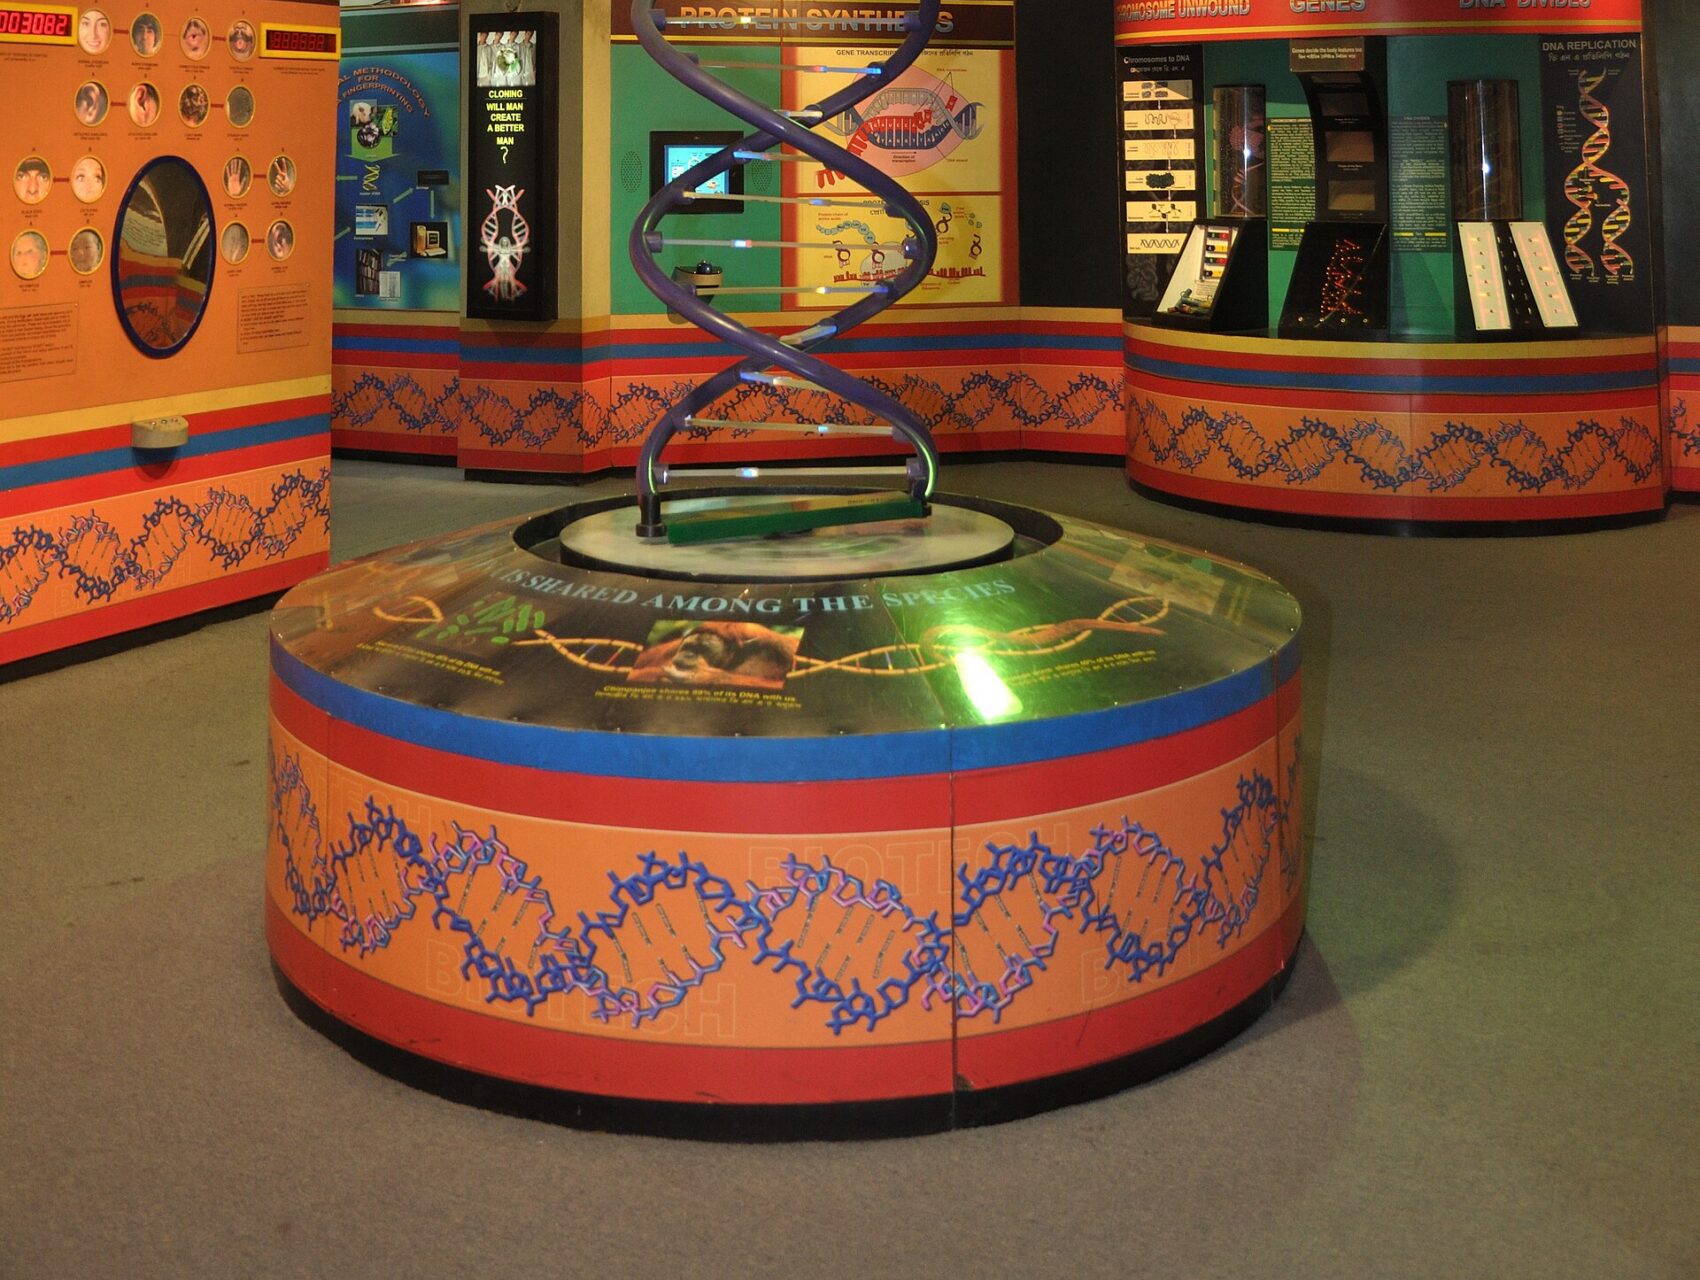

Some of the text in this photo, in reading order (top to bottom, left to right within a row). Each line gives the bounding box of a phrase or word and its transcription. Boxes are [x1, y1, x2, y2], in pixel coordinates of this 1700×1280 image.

[679, 6, 954, 33] PROTEIN SYNTHES
[1543, 39, 1637, 51] DNA REPLICATION
[1124, 55, 1167, 64] Chromosomes
[1176, 54, 1190, 62] DNA
[353, 67, 431, 118] METHODOLOGY
[489, 90, 523, 98] CLONING
[486, 102, 524, 111] WILL MAN
[490, 113, 521, 121] CREATE
[487, 124, 524, 132] A BETTER
[496, 137, 514, 145] MAN
[523, 575, 638, 604] SHARED
[641, 593, 783, 613] AMONG
[792, 595, 874, 612] THE
[882, 579, 1016, 607] SPECIES
[739, 691, 760, 699] DNA
